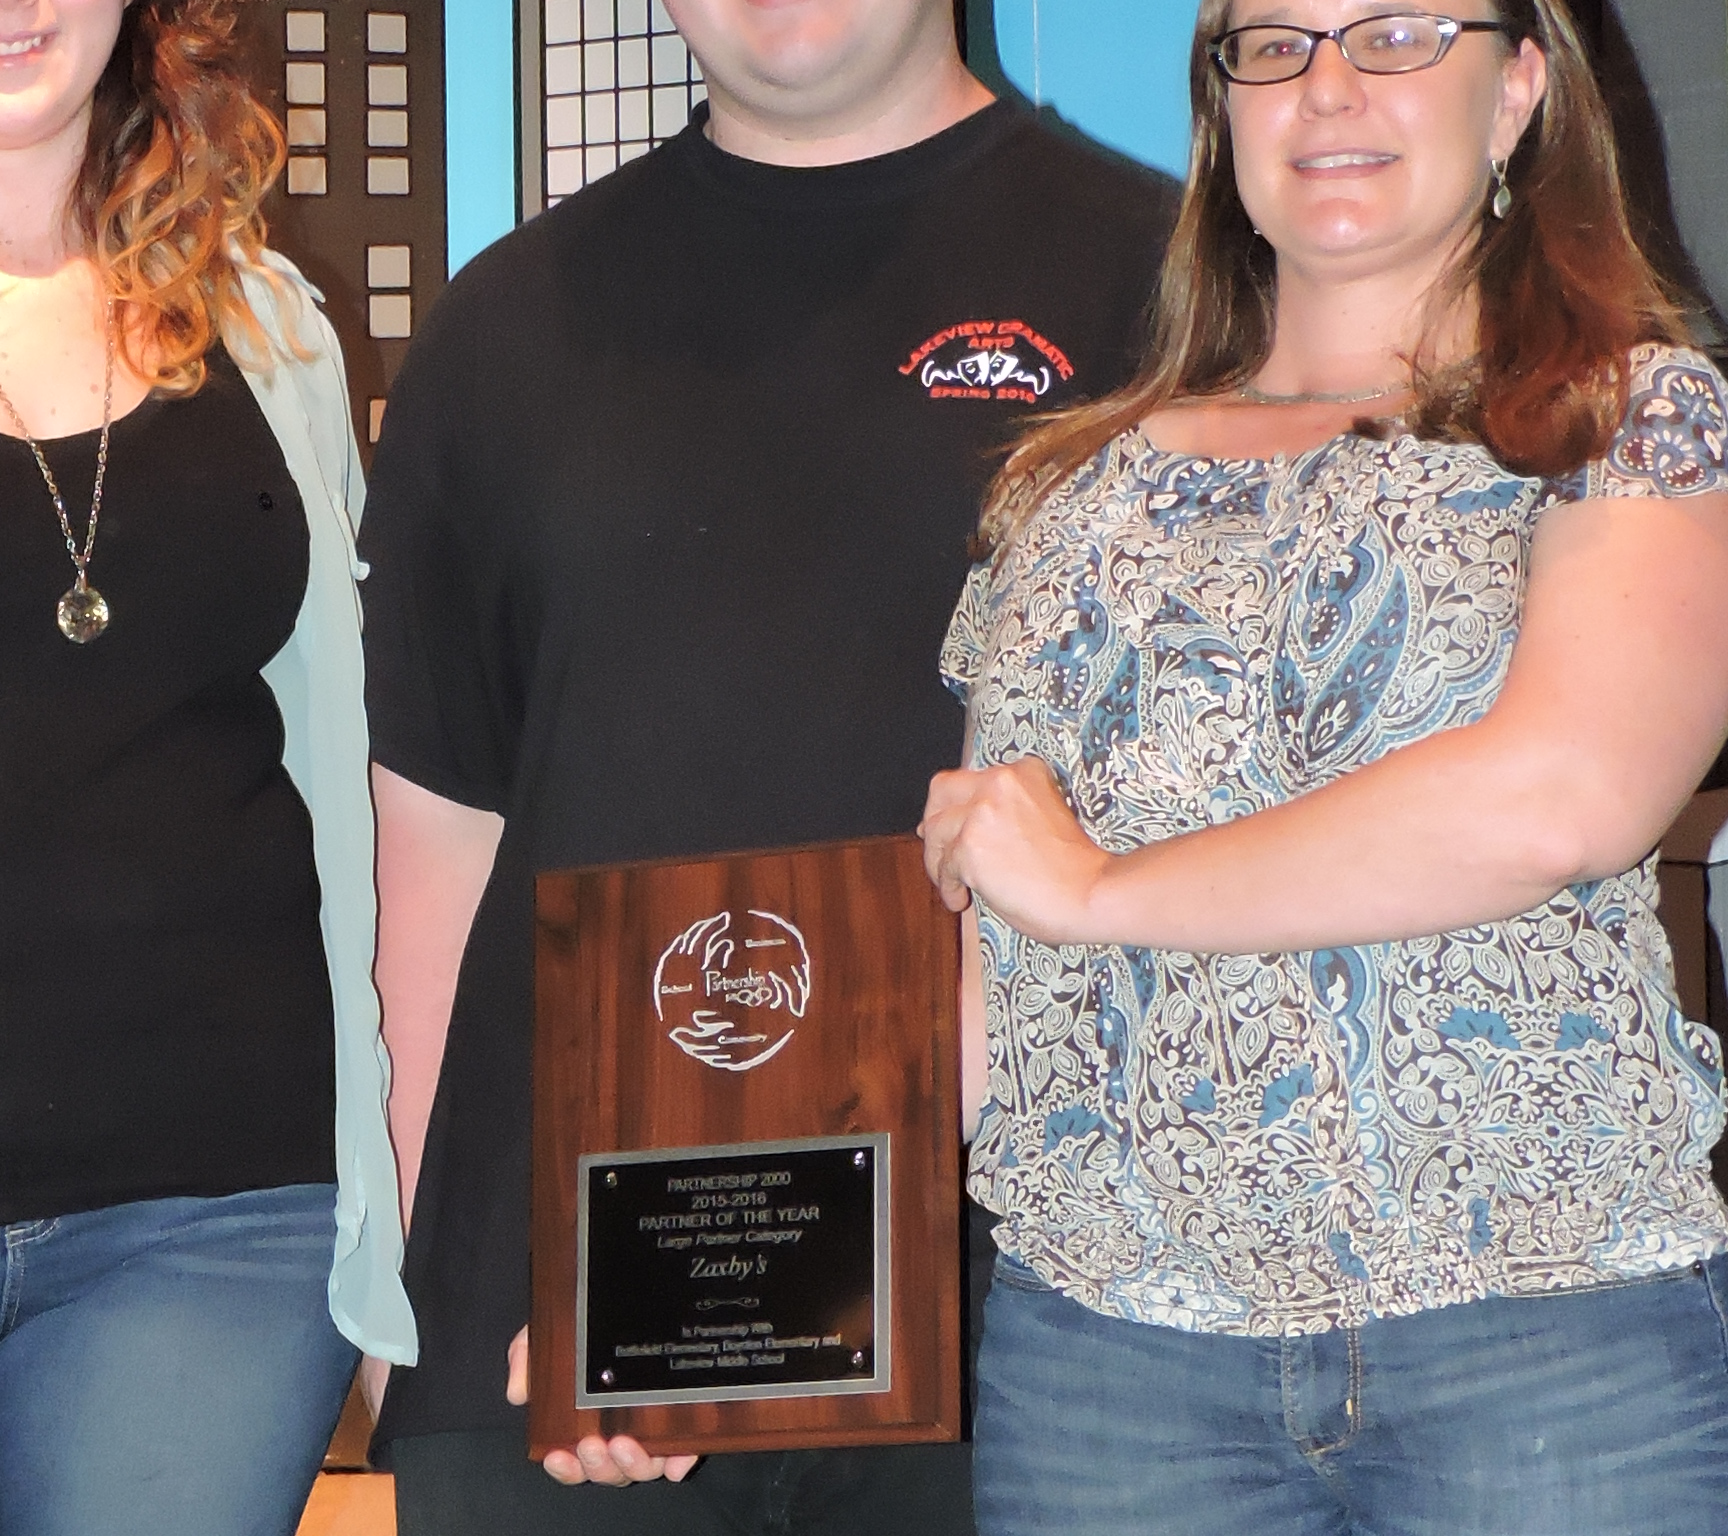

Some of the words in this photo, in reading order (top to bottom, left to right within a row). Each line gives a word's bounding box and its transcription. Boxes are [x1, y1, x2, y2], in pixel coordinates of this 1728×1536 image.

[667, 1174, 758, 1193] PARTNERSHIP
[760, 1171, 792, 1187] 2000
[691, 1191, 768, 1210] 2015-2016
[638, 1213, 712, 1232] PARTNER
[716, 1211, 736, 1226] OF
[743, 1209, 773, 1224] THE
[777, 1206, 821, 1222] YEAR
[689, 1253, 769, 1281] Zaxby's
